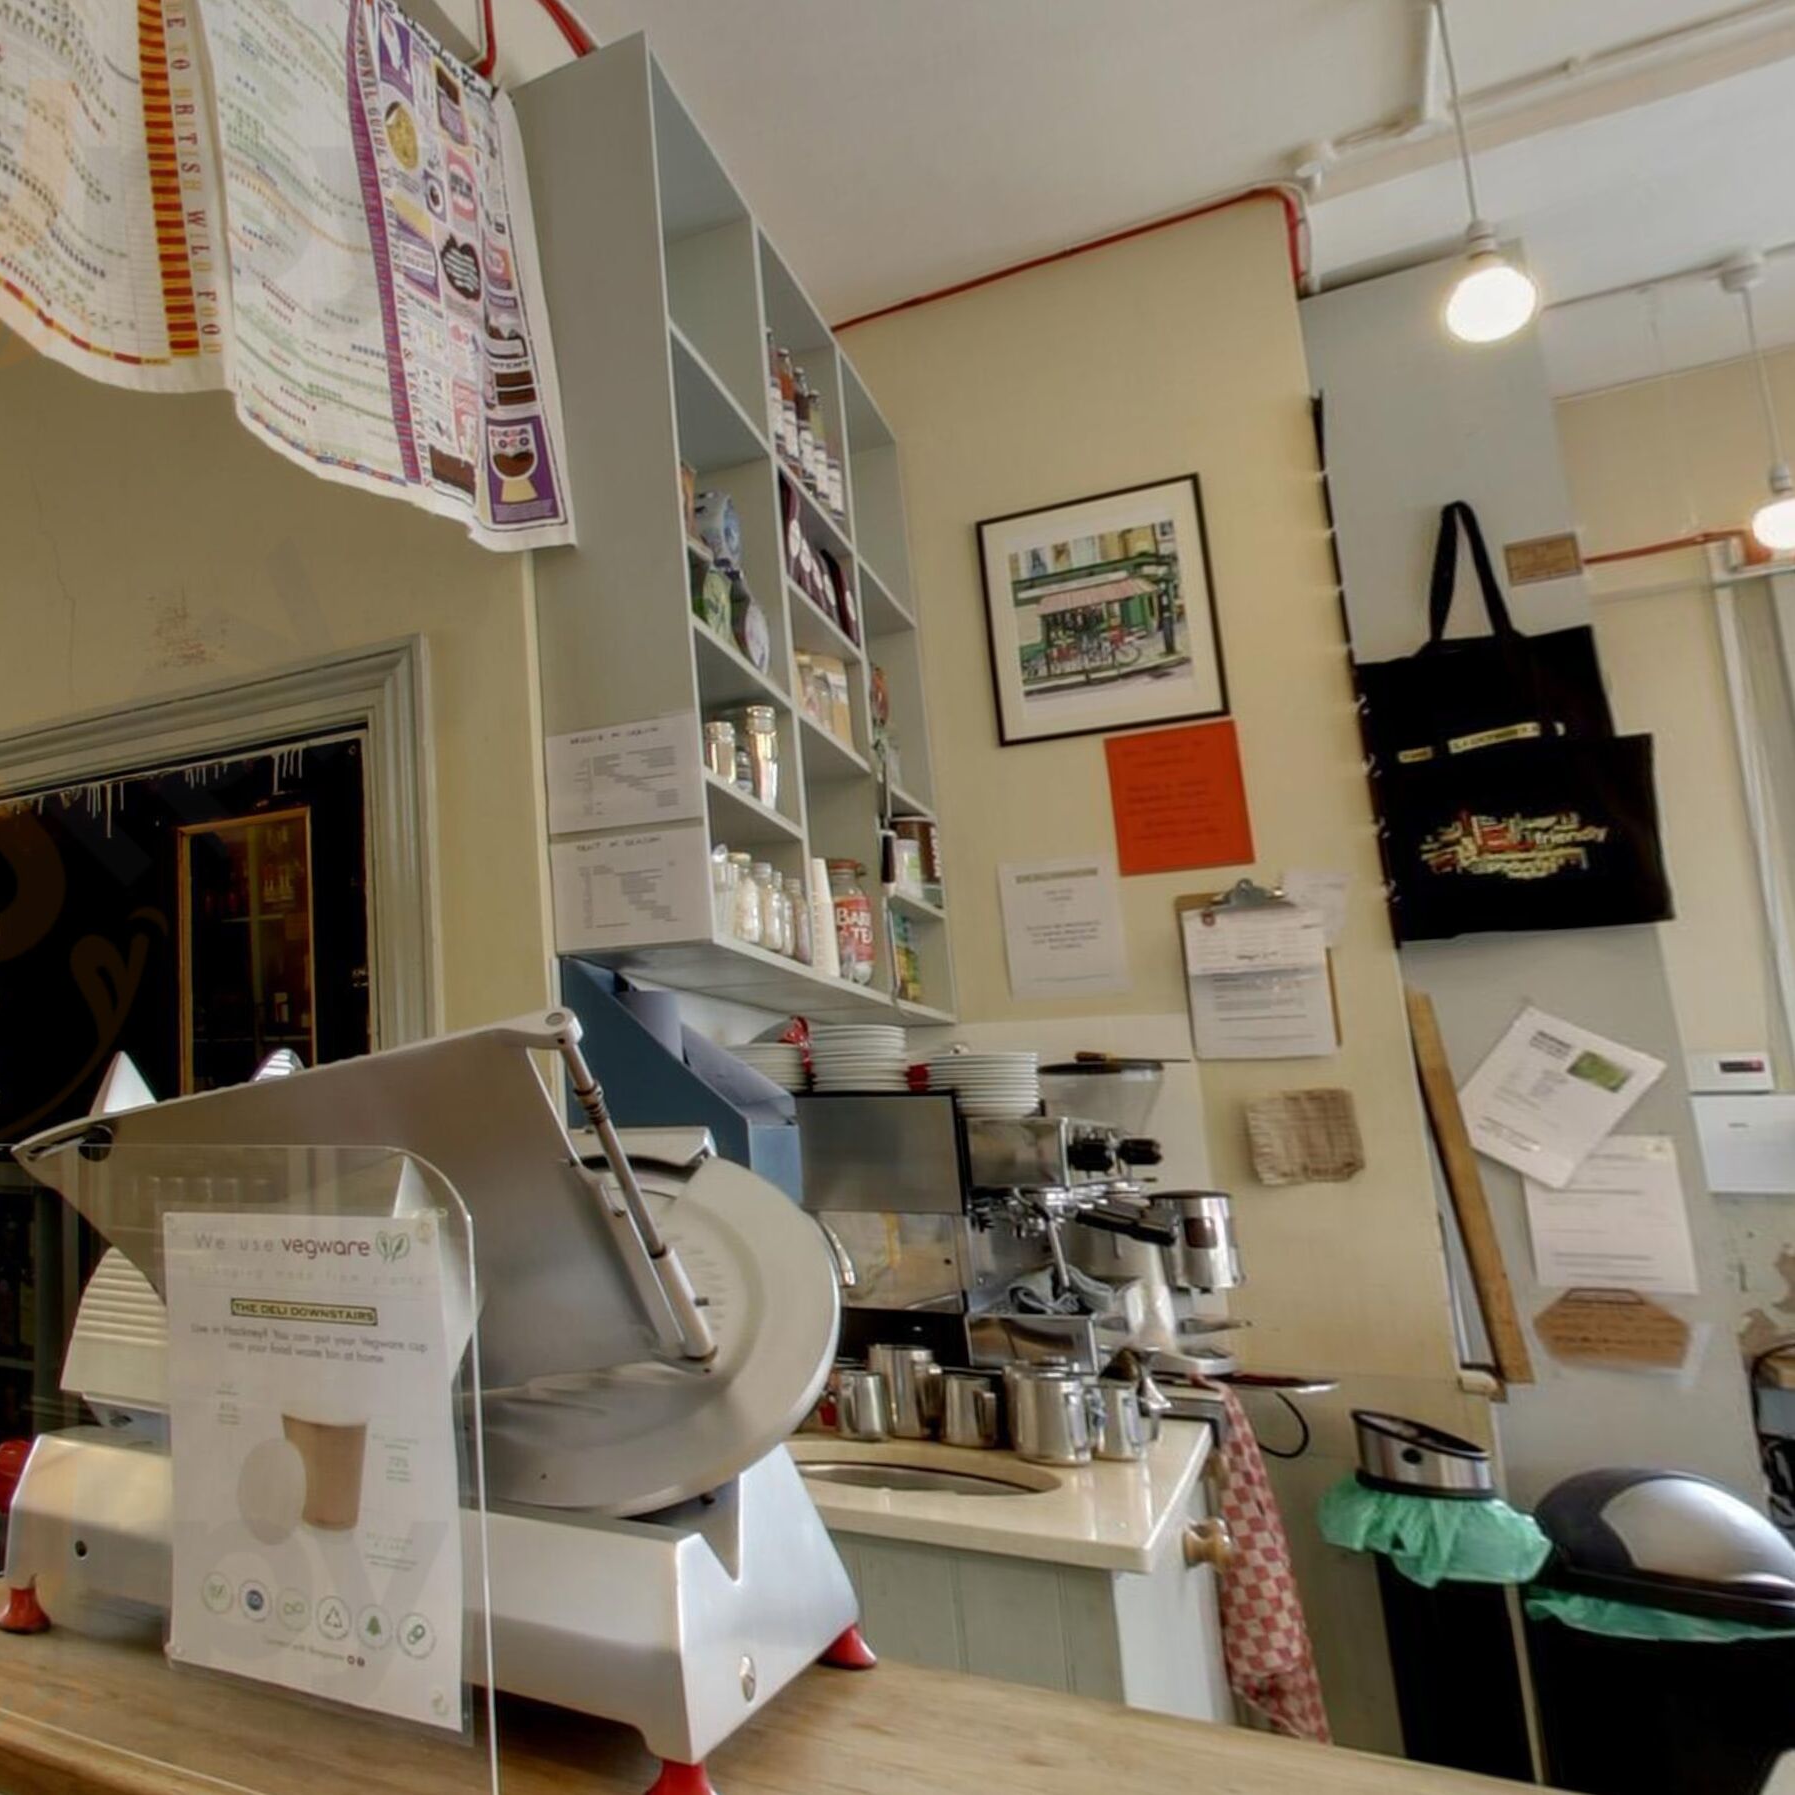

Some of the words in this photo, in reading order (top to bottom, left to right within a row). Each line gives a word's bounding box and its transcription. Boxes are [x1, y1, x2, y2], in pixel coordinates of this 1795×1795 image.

[194, 1232, 227, 1250] We
[239, 1236, 274, 1252] use
[281, 1236, 371, 1259] vegware
[235, 1302, 258, 1314] THE
[260, 1304, 288, 1316] DELI
[290, 1306, 375, 1322] DOWNSTAIRS
